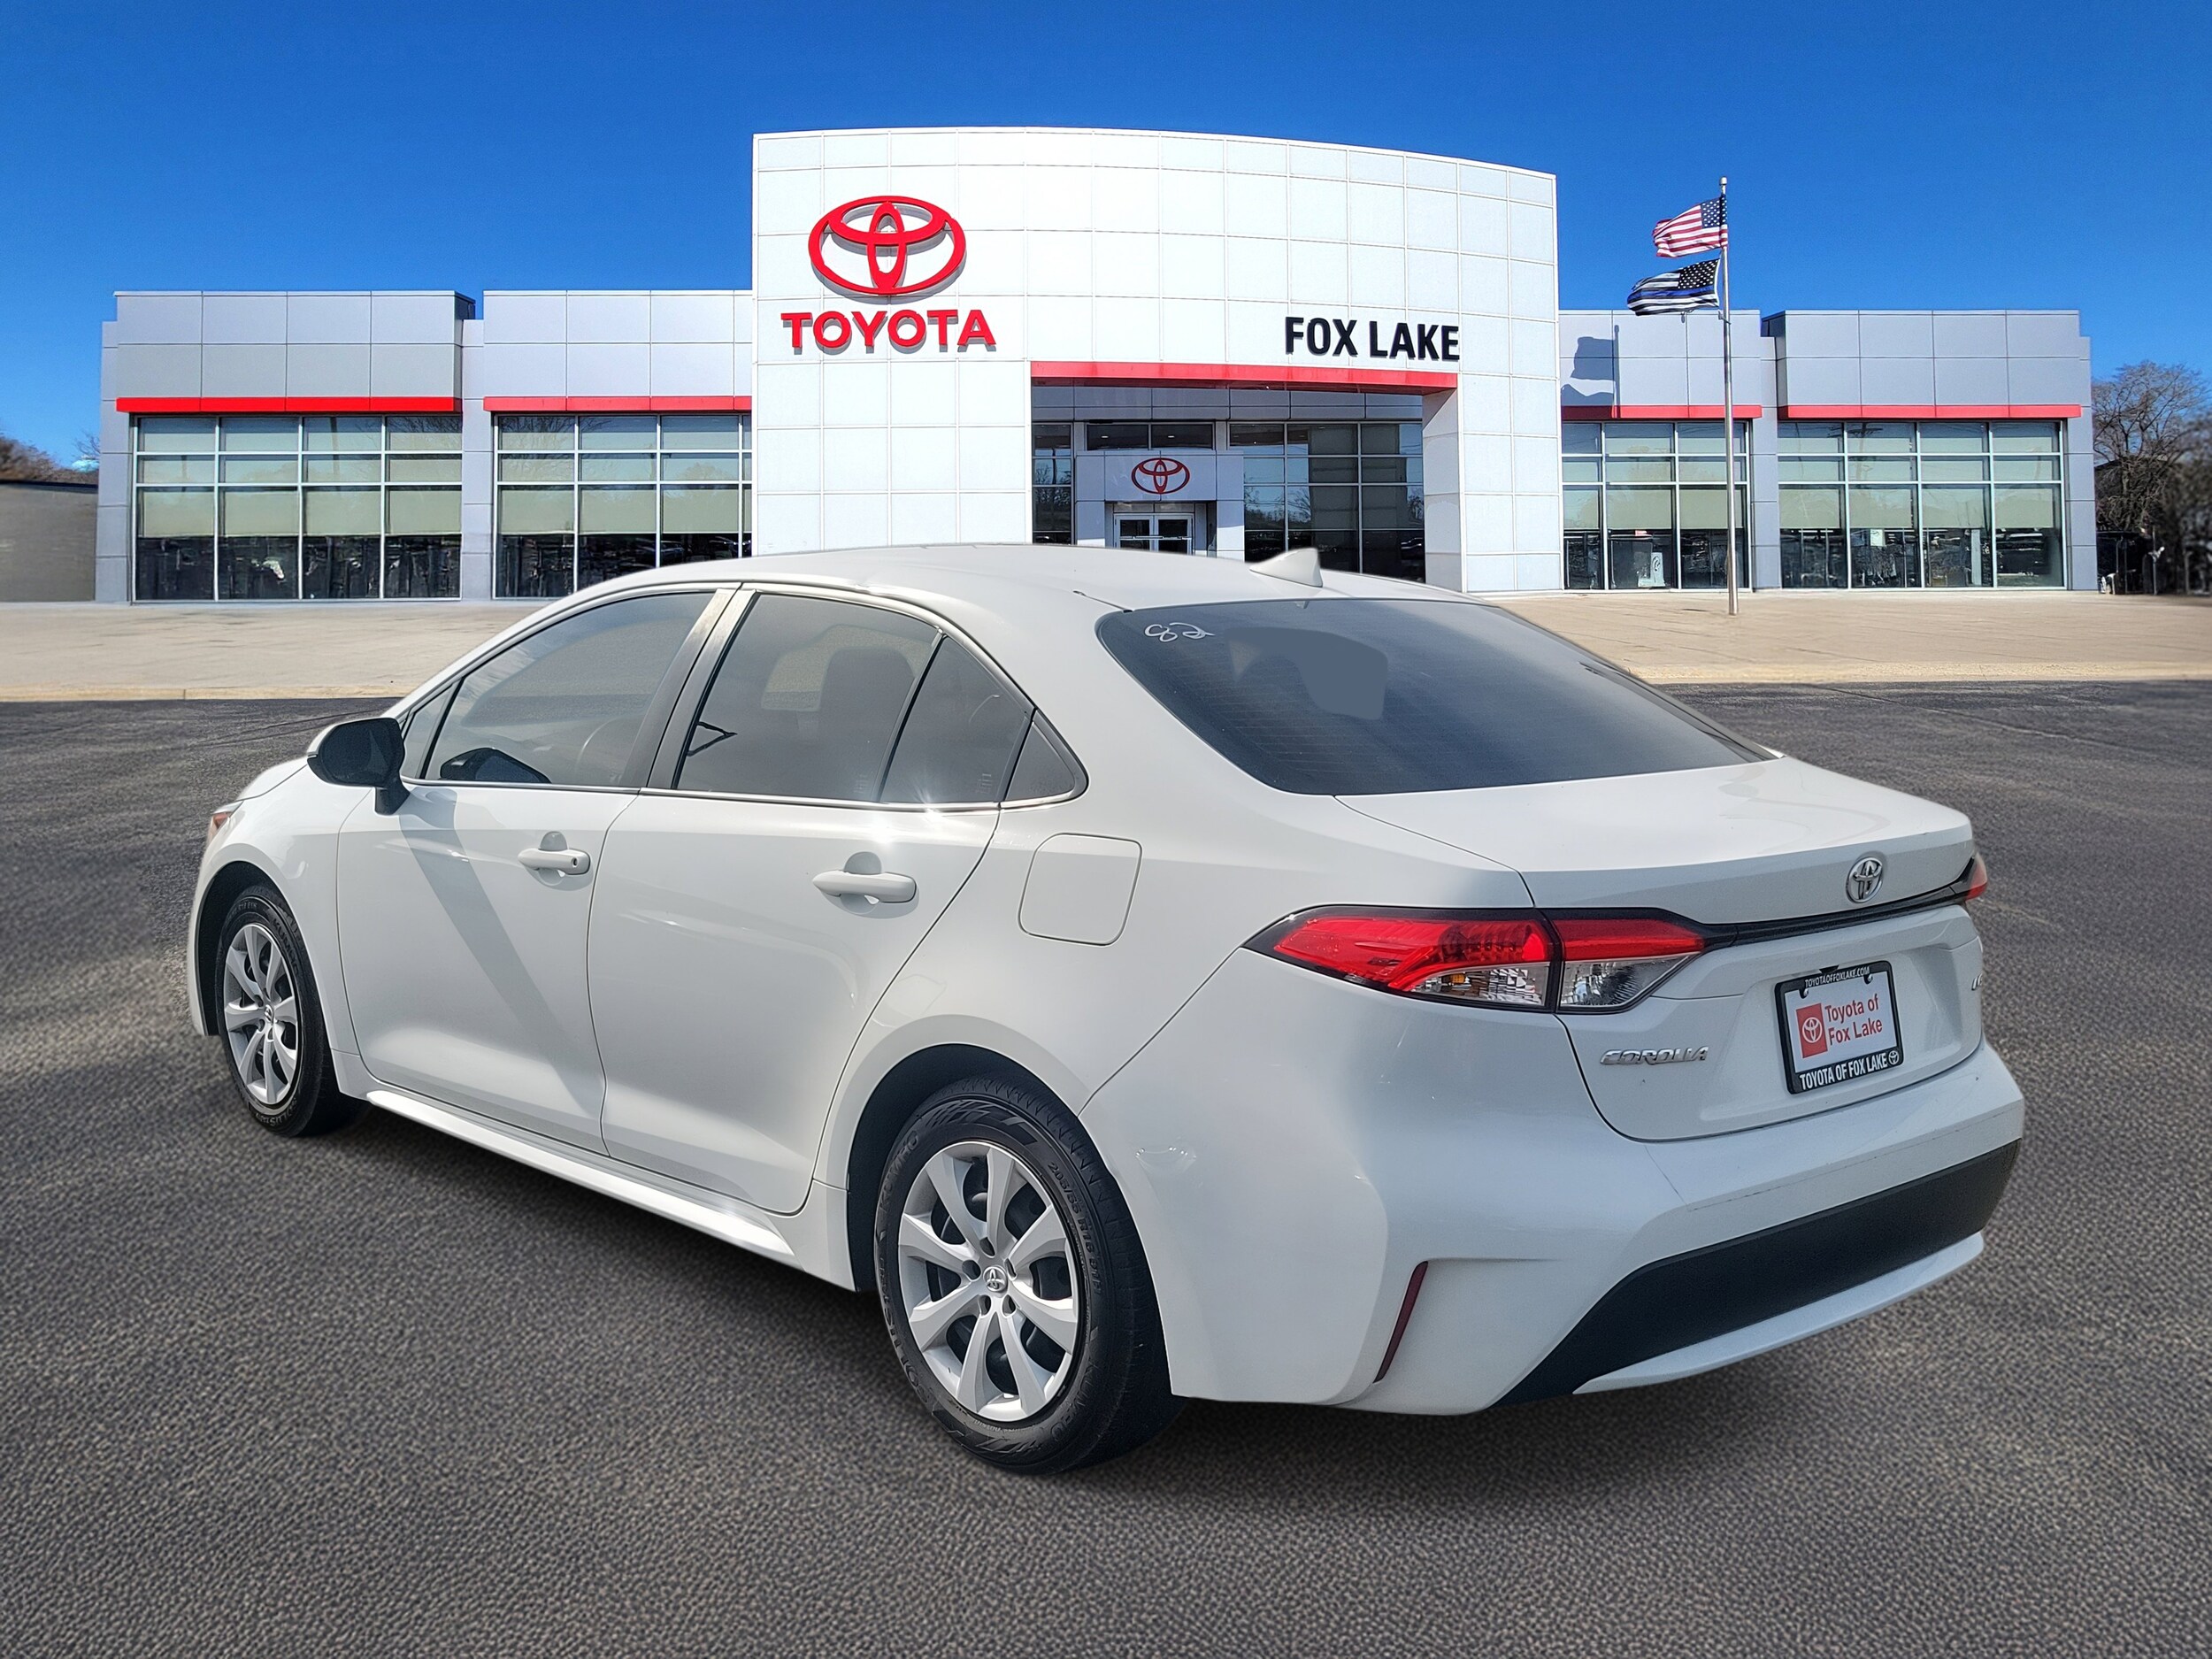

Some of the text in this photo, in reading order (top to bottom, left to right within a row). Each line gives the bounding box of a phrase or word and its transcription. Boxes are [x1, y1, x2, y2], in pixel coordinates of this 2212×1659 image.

[780, 309, 996, 355] TOYOTA
[1286, 316, 1460, 362] FOX LAKE
[1144, 622, 1216, 642] 82
[1805, 966, 1870, 988] TOYOTAOFFOXLAKE.COM
[1824, 993, 1879, 1024] Toyota of
[1828, 1018, 1883, 1046] Fox Lake
[1600, 1045, 1709, 1065] COROLLA
[1799, 1052, 1888, 1090] TOYOTA OF FOX LAKE
